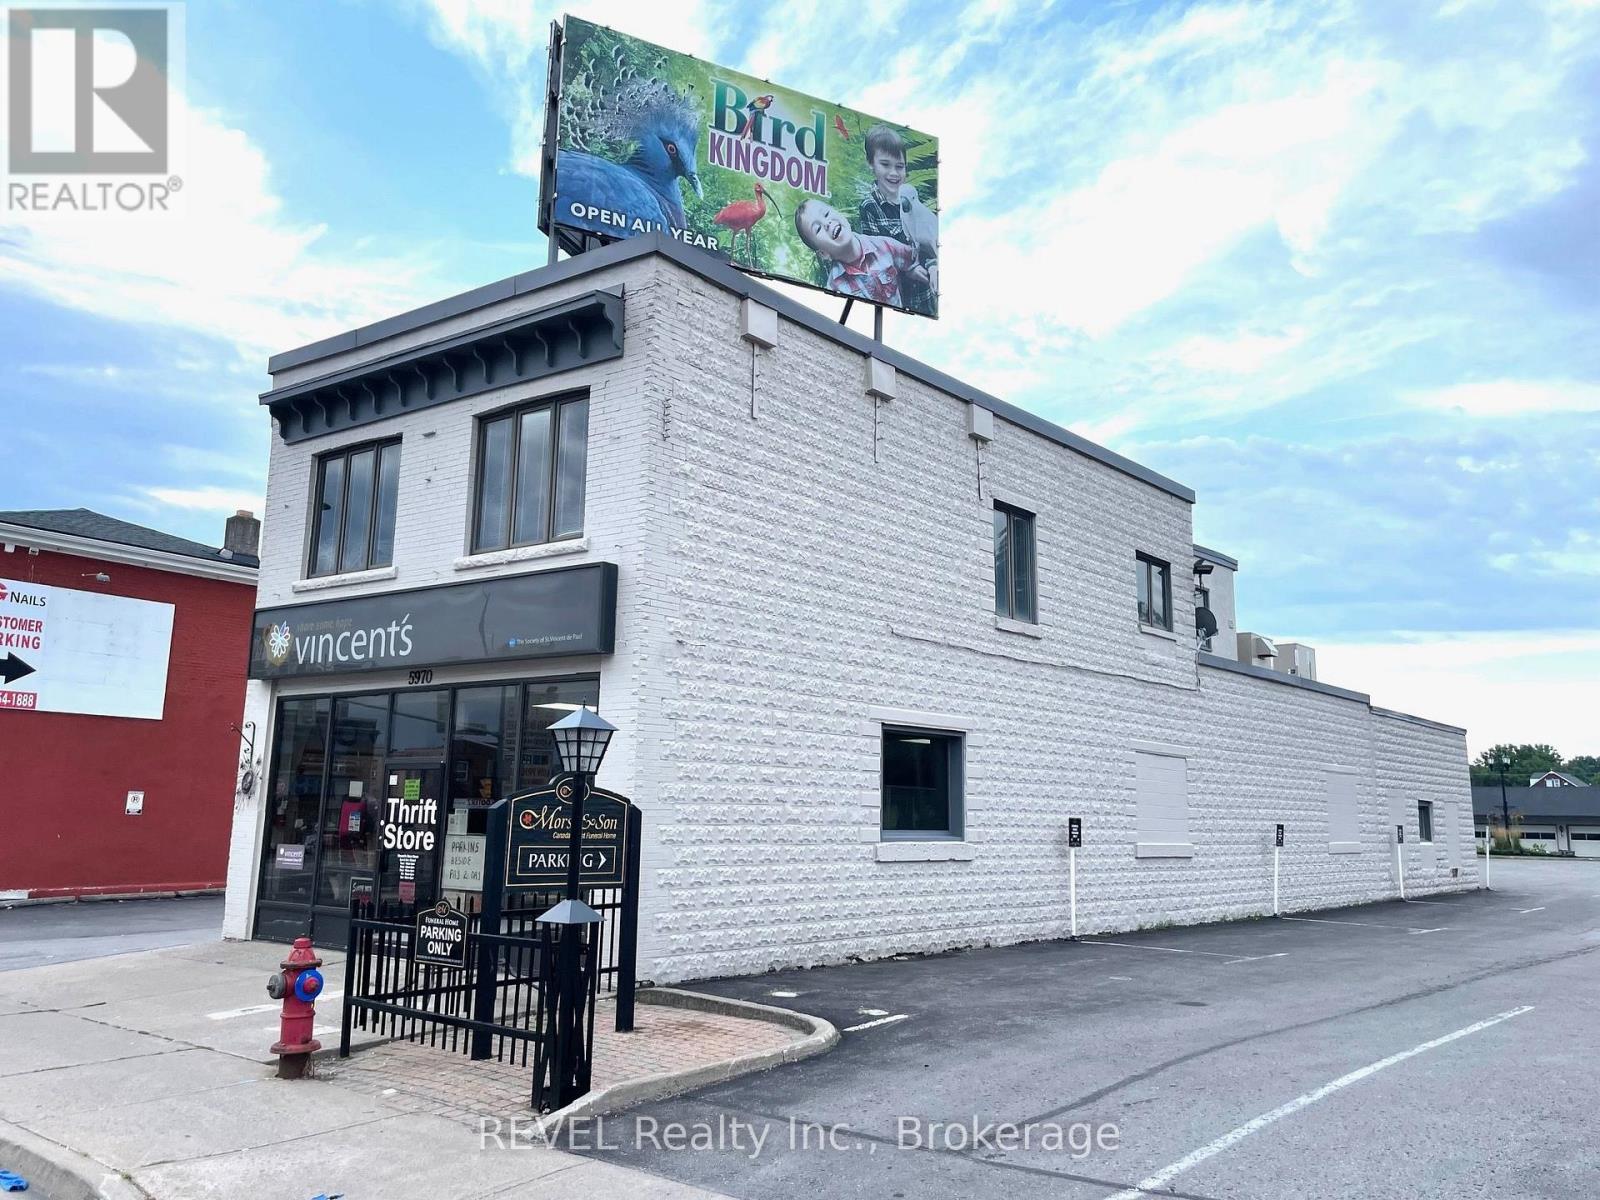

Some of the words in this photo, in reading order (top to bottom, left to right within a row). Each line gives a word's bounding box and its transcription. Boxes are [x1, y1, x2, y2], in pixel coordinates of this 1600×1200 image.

[708, 77, 828, 163] Bird
[709, 132, 826, 195] KINGDOM
[570, 202, 626, 228] OPEN
[670, 226, 718, 251] YEAR
[10, 591, 46, 607] NAILS
[408, 670, 433, 686] 5970
[387, 798, 438, 825] Thrift
[520, 805, 572, 830] Mors
[595, 813, 618, 830] Son
[384, 823, 435, 851] Store
[586, 831, 602, 840] Funeral
[603, 832, 616, 840] Home
[528, 853, 594, 869] PARKIG
[420, 925, 462, 942] PARKING
[427, 941, 454, 956] ONLY
